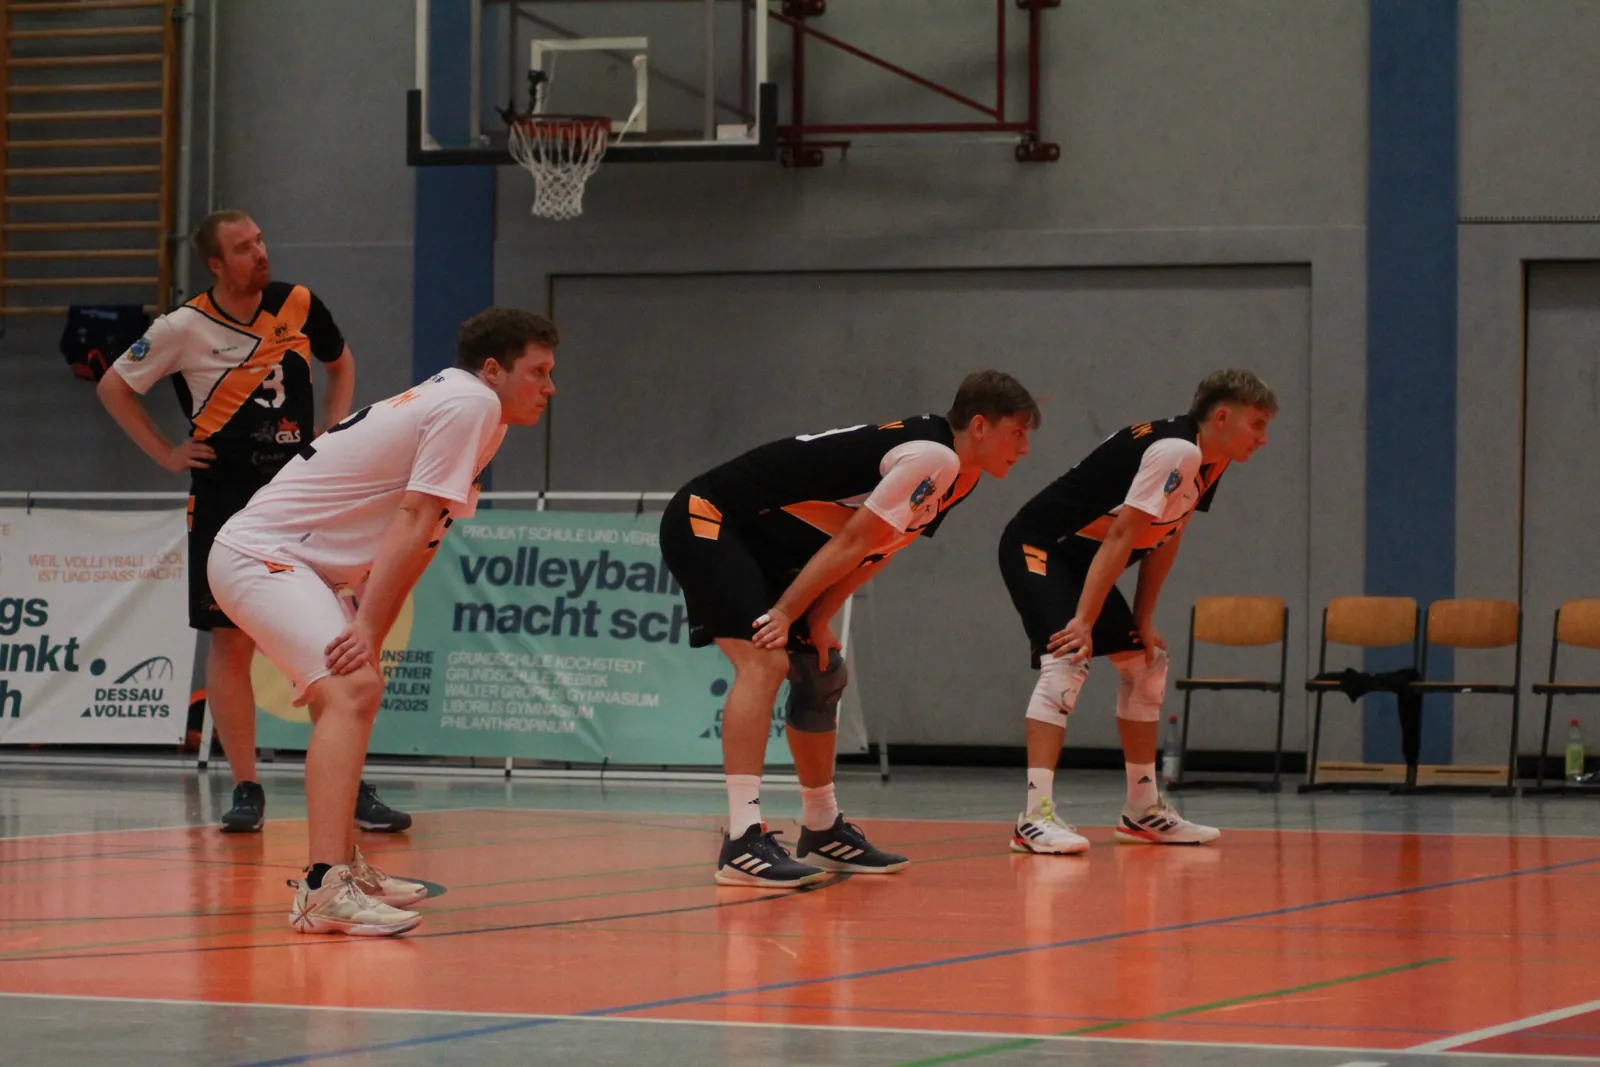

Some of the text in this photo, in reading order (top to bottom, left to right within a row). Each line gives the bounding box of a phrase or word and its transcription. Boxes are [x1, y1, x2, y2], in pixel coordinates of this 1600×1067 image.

[462, 525, 528, 539] PROJEKT
[529, 527, 586, 542] SCHULE
[588, 530, 619, 544] UND
[64, 554, 146, 568] VOLLEYBALL
[38, 570, 58, 583] IST
[63, 570, 91, 583] UND
[93, 569, 135, 582] SPASS
[453, 597, 602, 638] macht
[447, 651, 645, 674] GRUNDSCHULE KOCHSTEDT
[446, 668, 551, 684] GRUNDSCHULE
[95, 689, 163, 701] DESSAU
[444, 684, 499, 698] WALTER
[566, 688, 659, 708] GYMNASIUM
[94, 705, 170, 717] VOLLEYS
[442, 700, 505, 714] LIBORIUS
[441, 716, 575, 734] PHILANTHROPINUM
